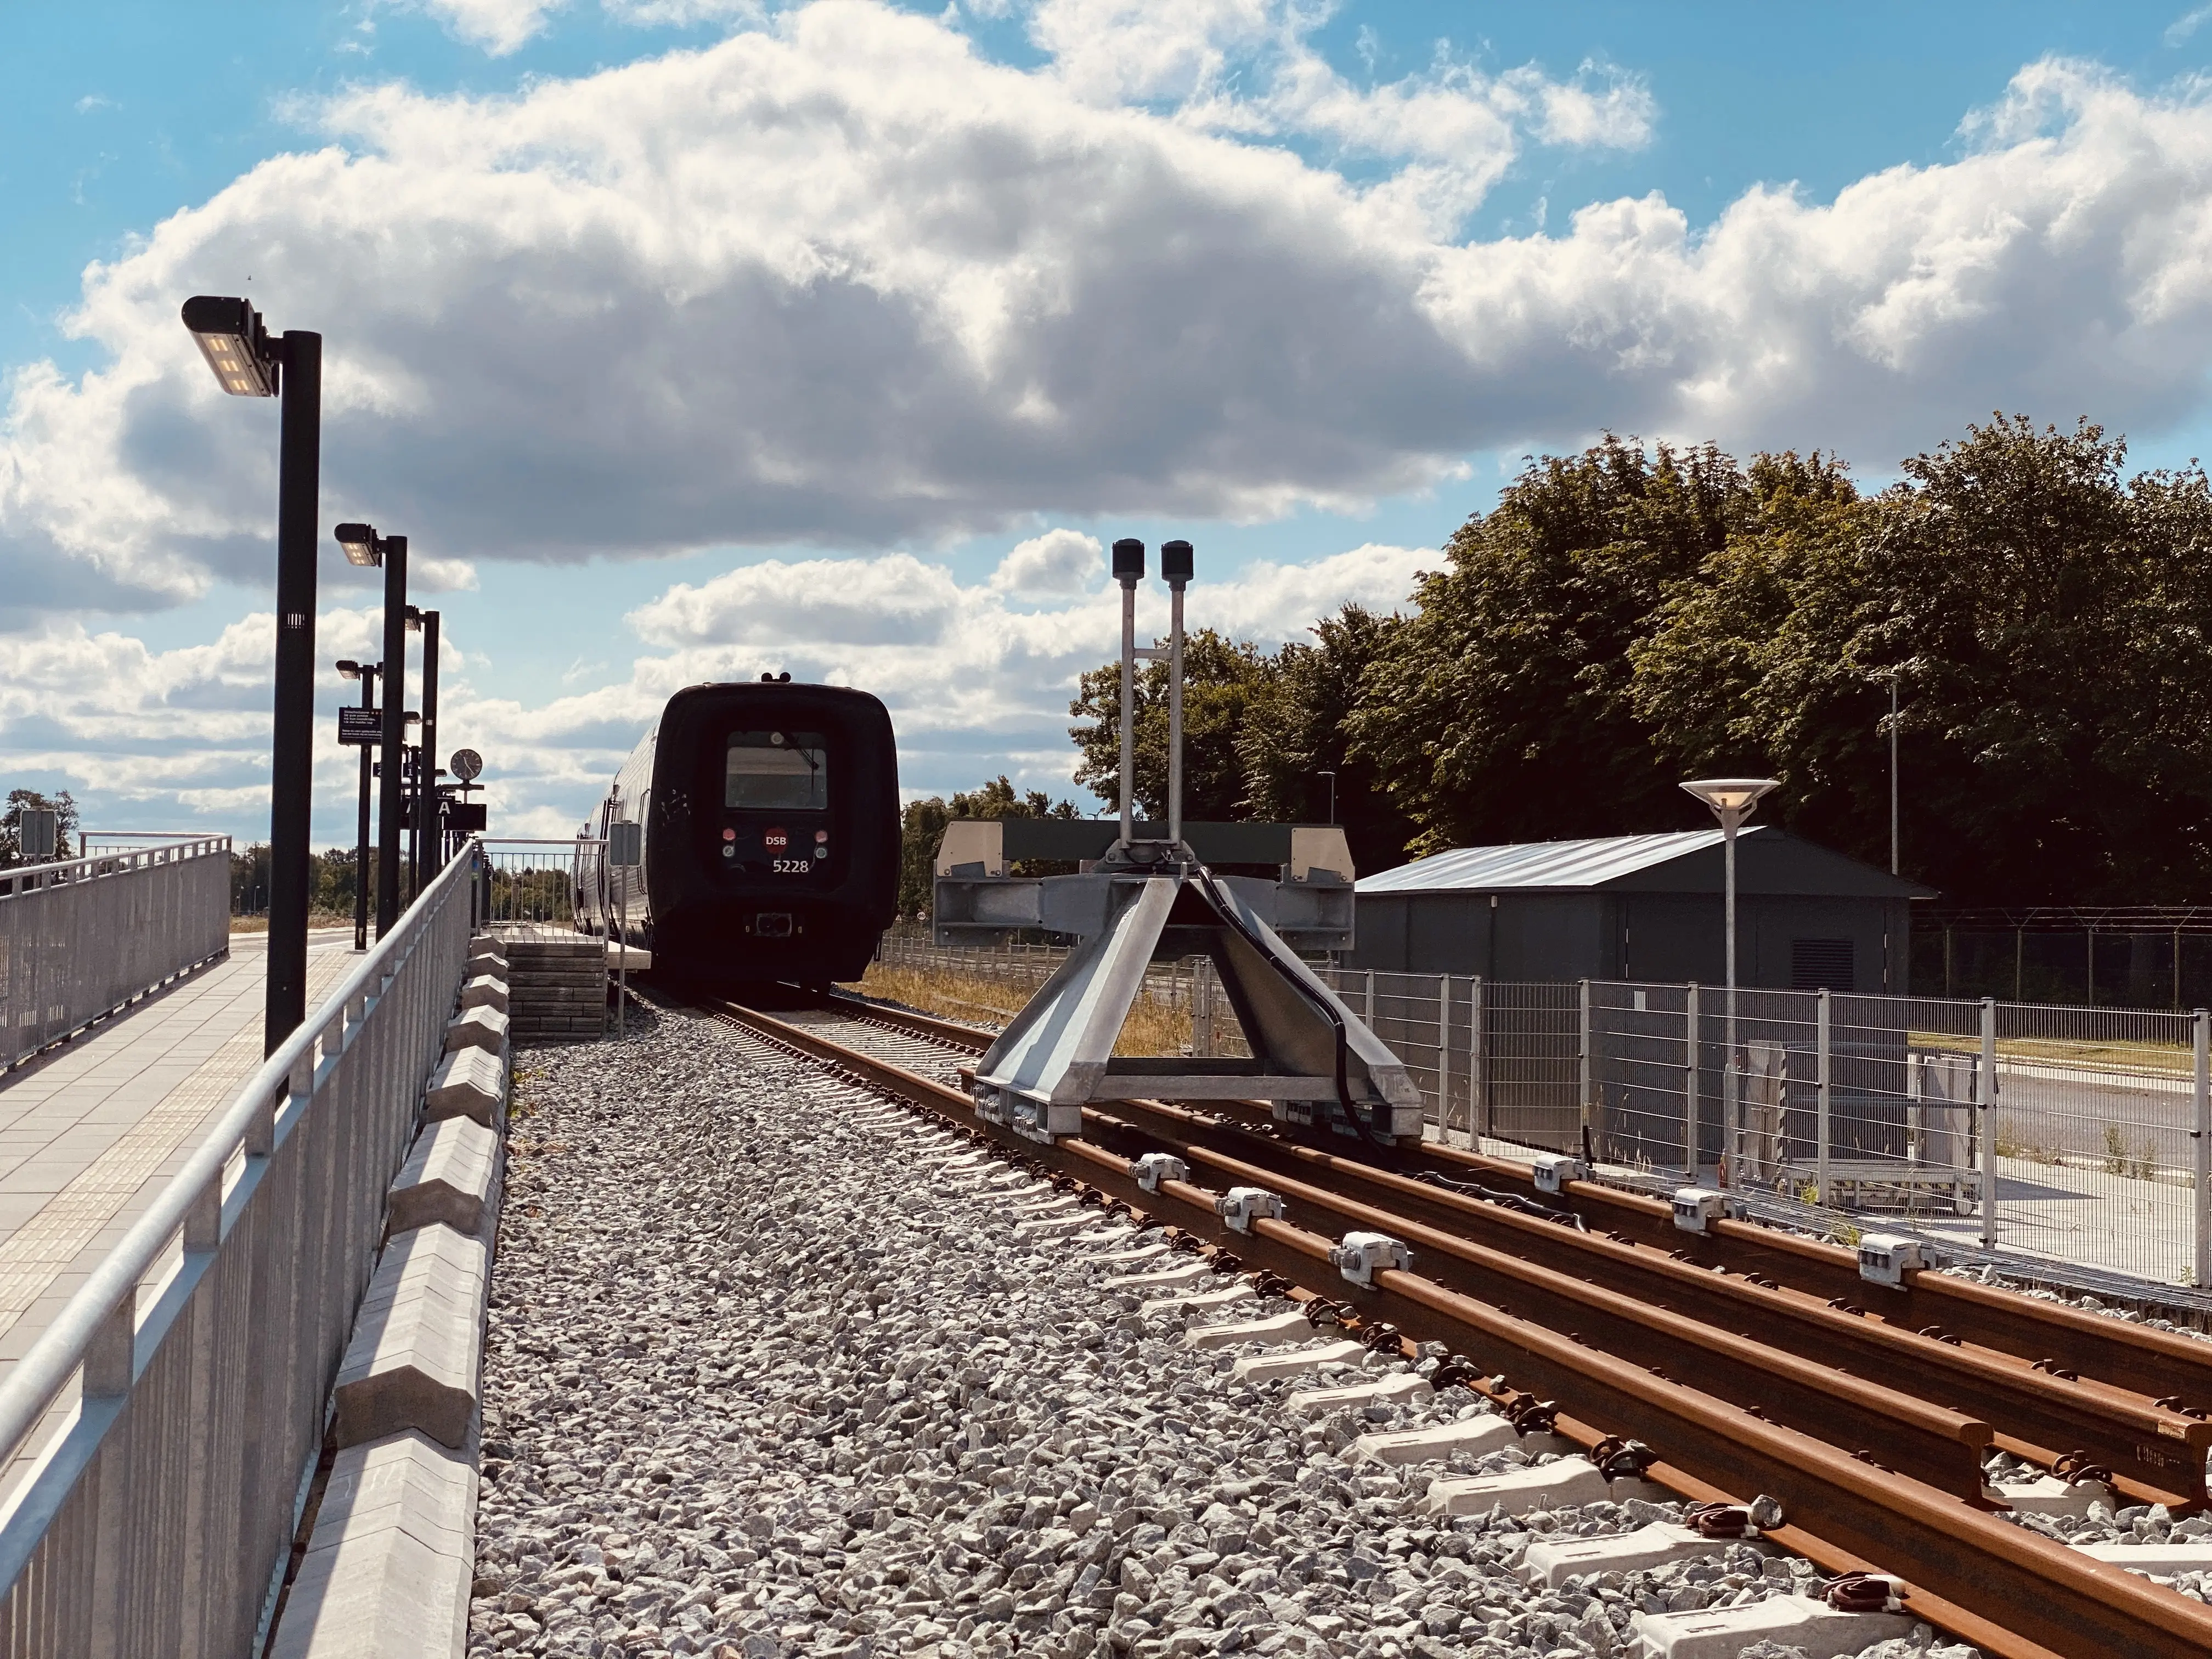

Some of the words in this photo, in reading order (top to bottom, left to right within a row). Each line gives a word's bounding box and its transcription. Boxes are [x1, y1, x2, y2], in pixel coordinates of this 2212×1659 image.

[438, 802, 450, 814] A
[766, 837, 786, 845] DSB
[773, 860, 809, 872] 5228
